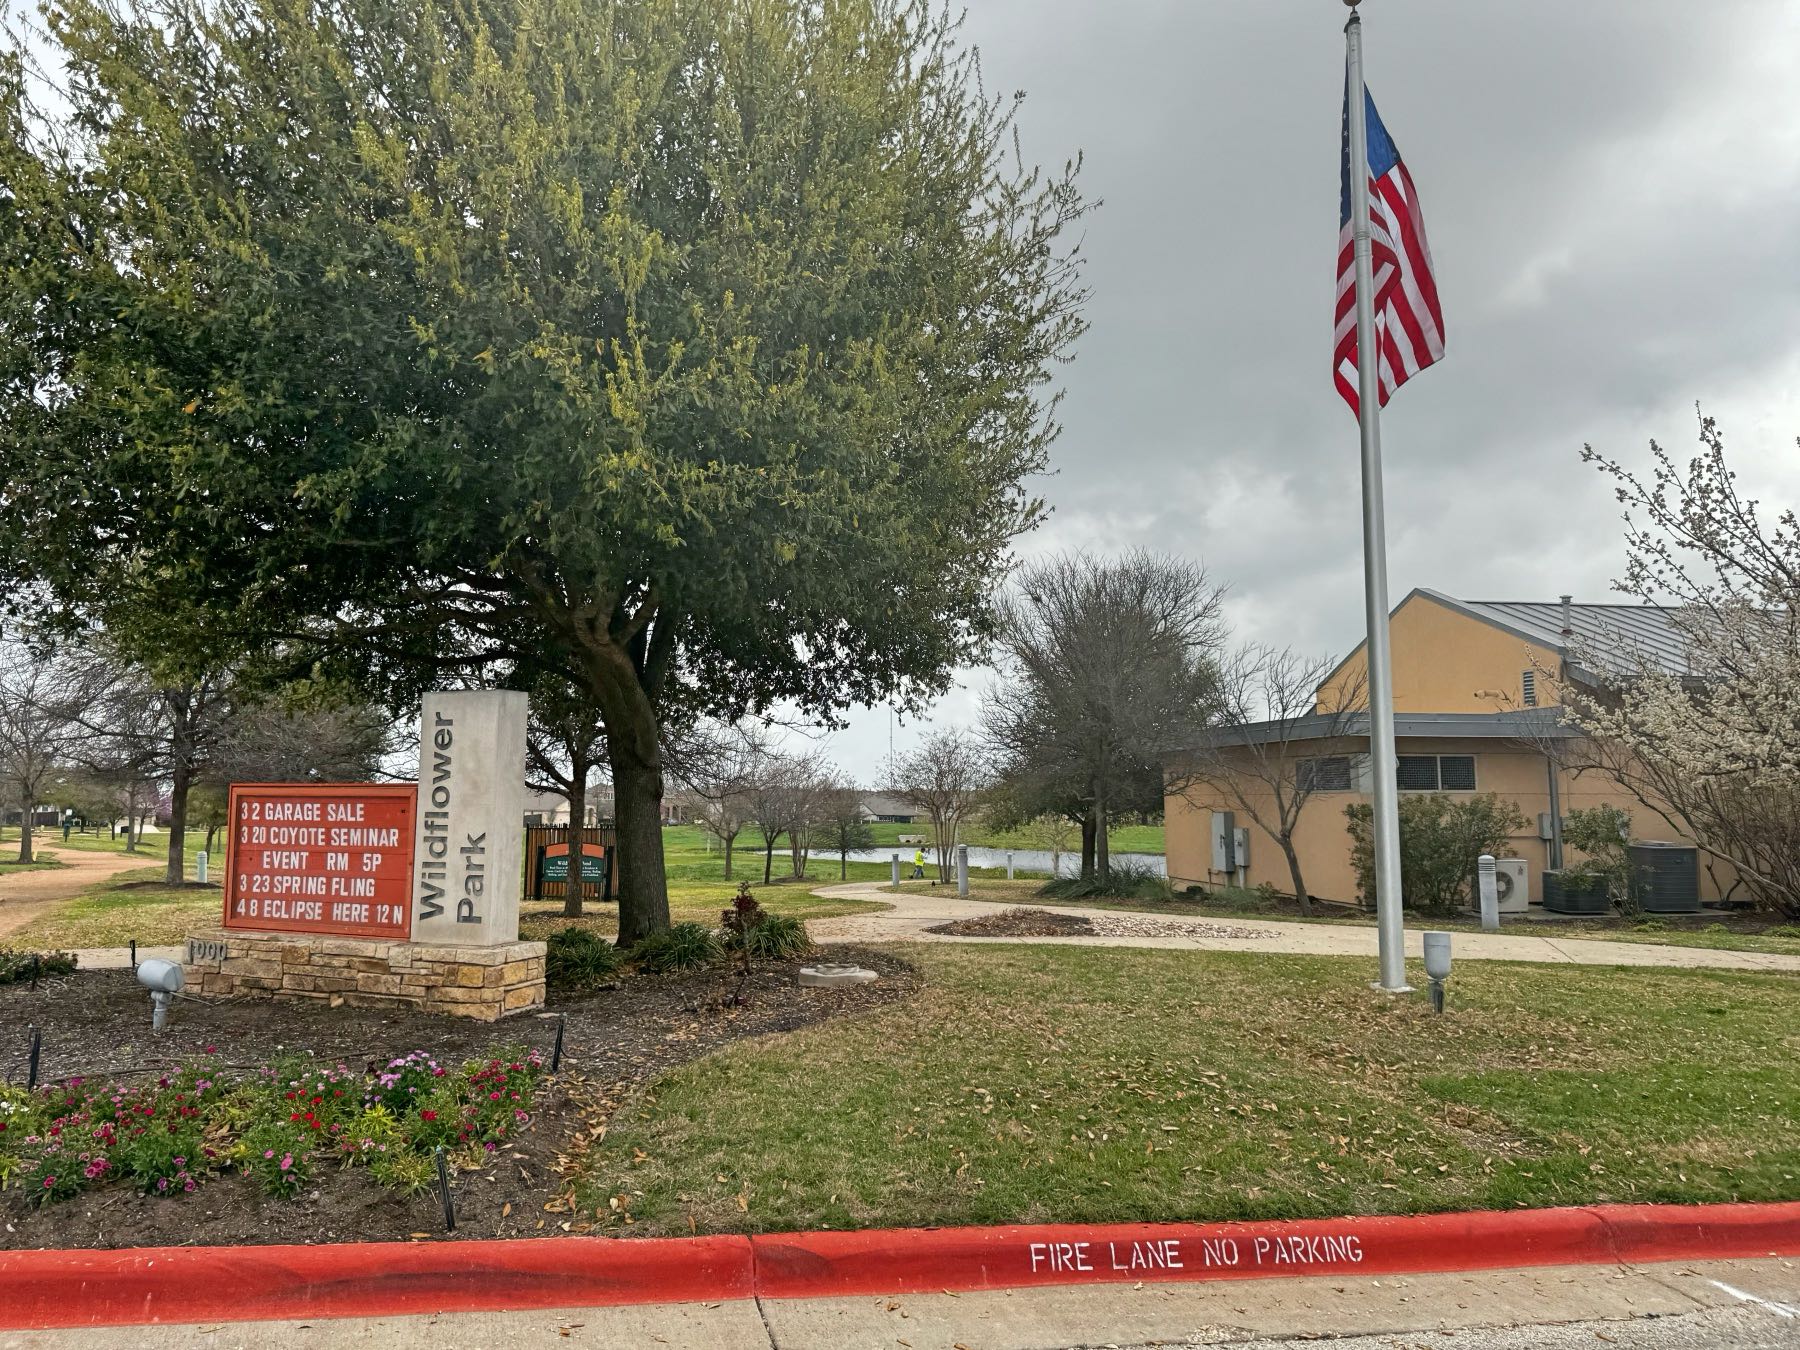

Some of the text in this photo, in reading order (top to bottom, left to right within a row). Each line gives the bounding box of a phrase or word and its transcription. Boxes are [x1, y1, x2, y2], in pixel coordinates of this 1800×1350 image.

[241, 802, 364, 822] 3 2 GARAGE SALE
[419, 711, 454, 921] Wildflower
[241, 827, 399, 847] 3 20 COYOTE SEMINAR
[263, 851, 382, 871] EVENT RM 5P
[240, 874, 375, 896] 3 23 SPRING FLING
[457, 831, 487, 924] Park
[237, 899, 403, 924] 4 8 ECLIPSE HERE 12 N
[1029, 1236, 1363, 1272] FIRE LANE NO PARKING
